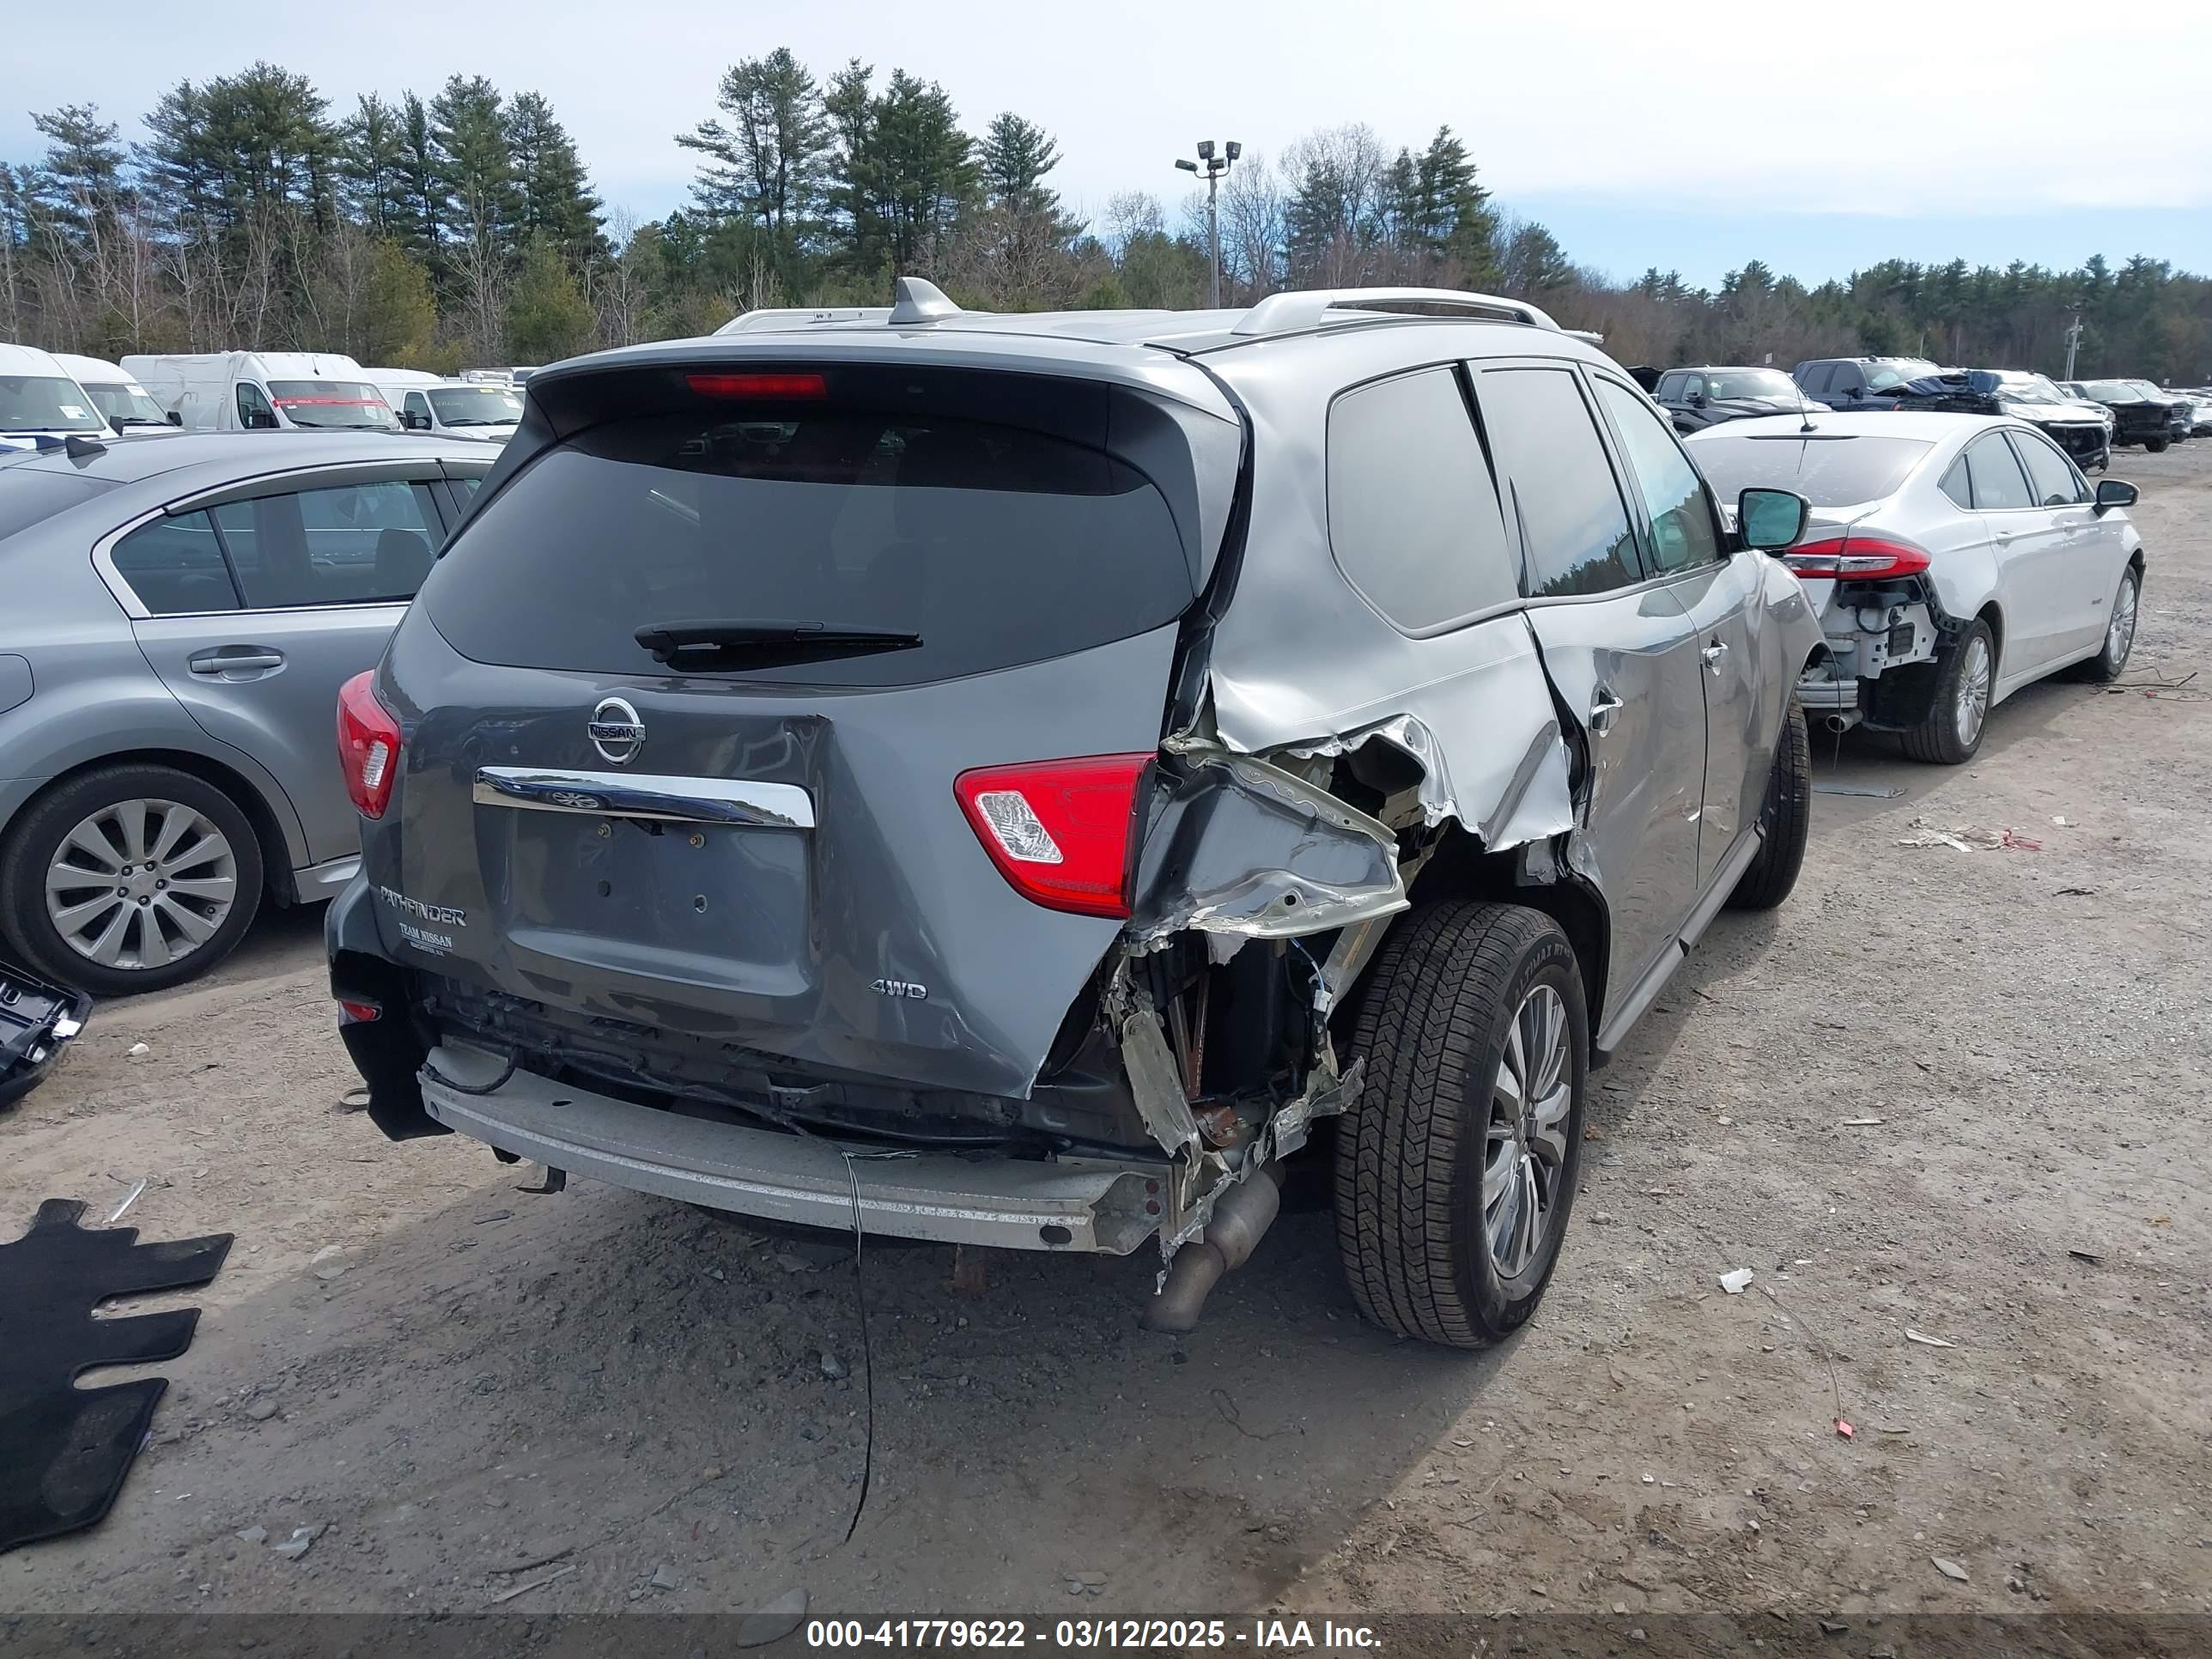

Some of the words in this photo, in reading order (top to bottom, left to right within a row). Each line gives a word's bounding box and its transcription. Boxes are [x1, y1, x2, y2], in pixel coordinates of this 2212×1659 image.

[590, 725, 637, 738] NISSAN
[380, 885, 467, 927] PATHFINDER
[398, 922, 420, 939] TEAM
[420, 930, 453, 948] NISSAN
[867, 979, 927, 1000] 4WD
